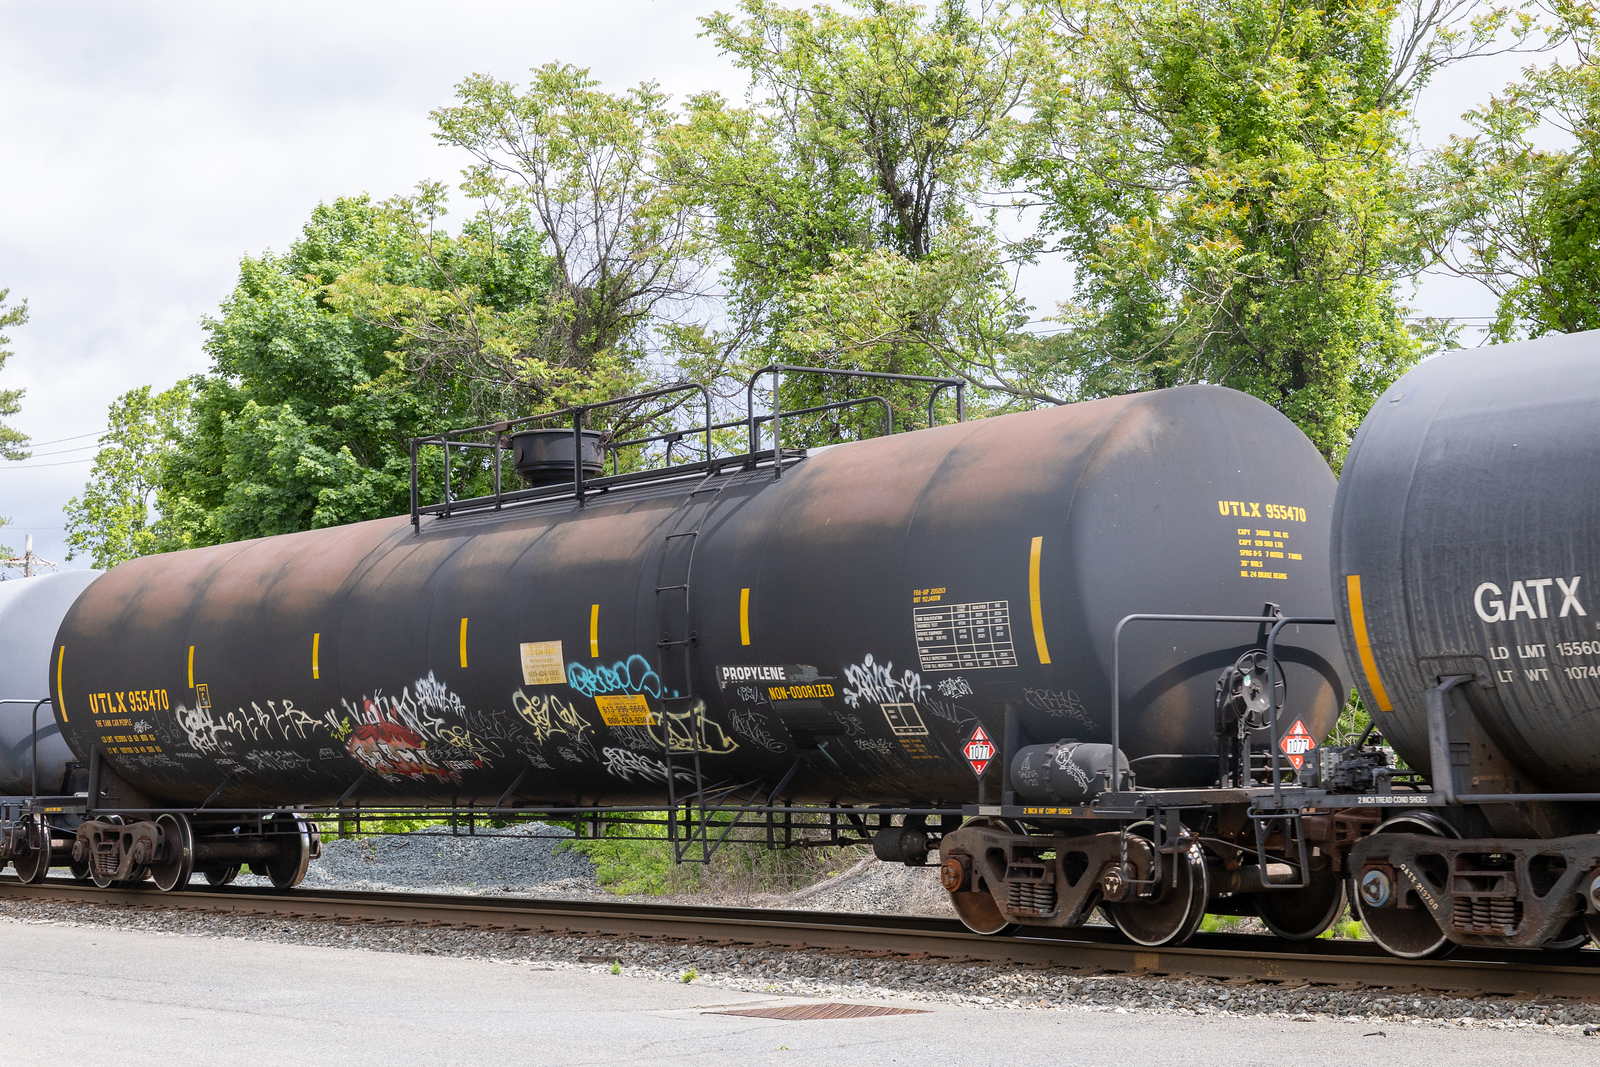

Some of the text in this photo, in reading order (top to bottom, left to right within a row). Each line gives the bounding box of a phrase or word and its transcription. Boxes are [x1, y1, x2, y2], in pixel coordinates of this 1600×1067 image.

[1218, 500, 1306, 522] UTLX 955470
[1474, 576, 1588, 623] GATX
[1490, 640, 1600, 660] LD LMT 15560
[722, 667, 786, 680] PROPYLENE
[1497, 670, 1513, 683] LT
[1524, 668, 1548, 682] WT
[768, 684, 835, 700] NON-ODORIZED
[88, 689, 169, 714] UTLX 955470
[971, 746, 988, 759] 1077
[1289, 740, 1307, 752] 1077
[1400, 864, 1417, 884] GATX
